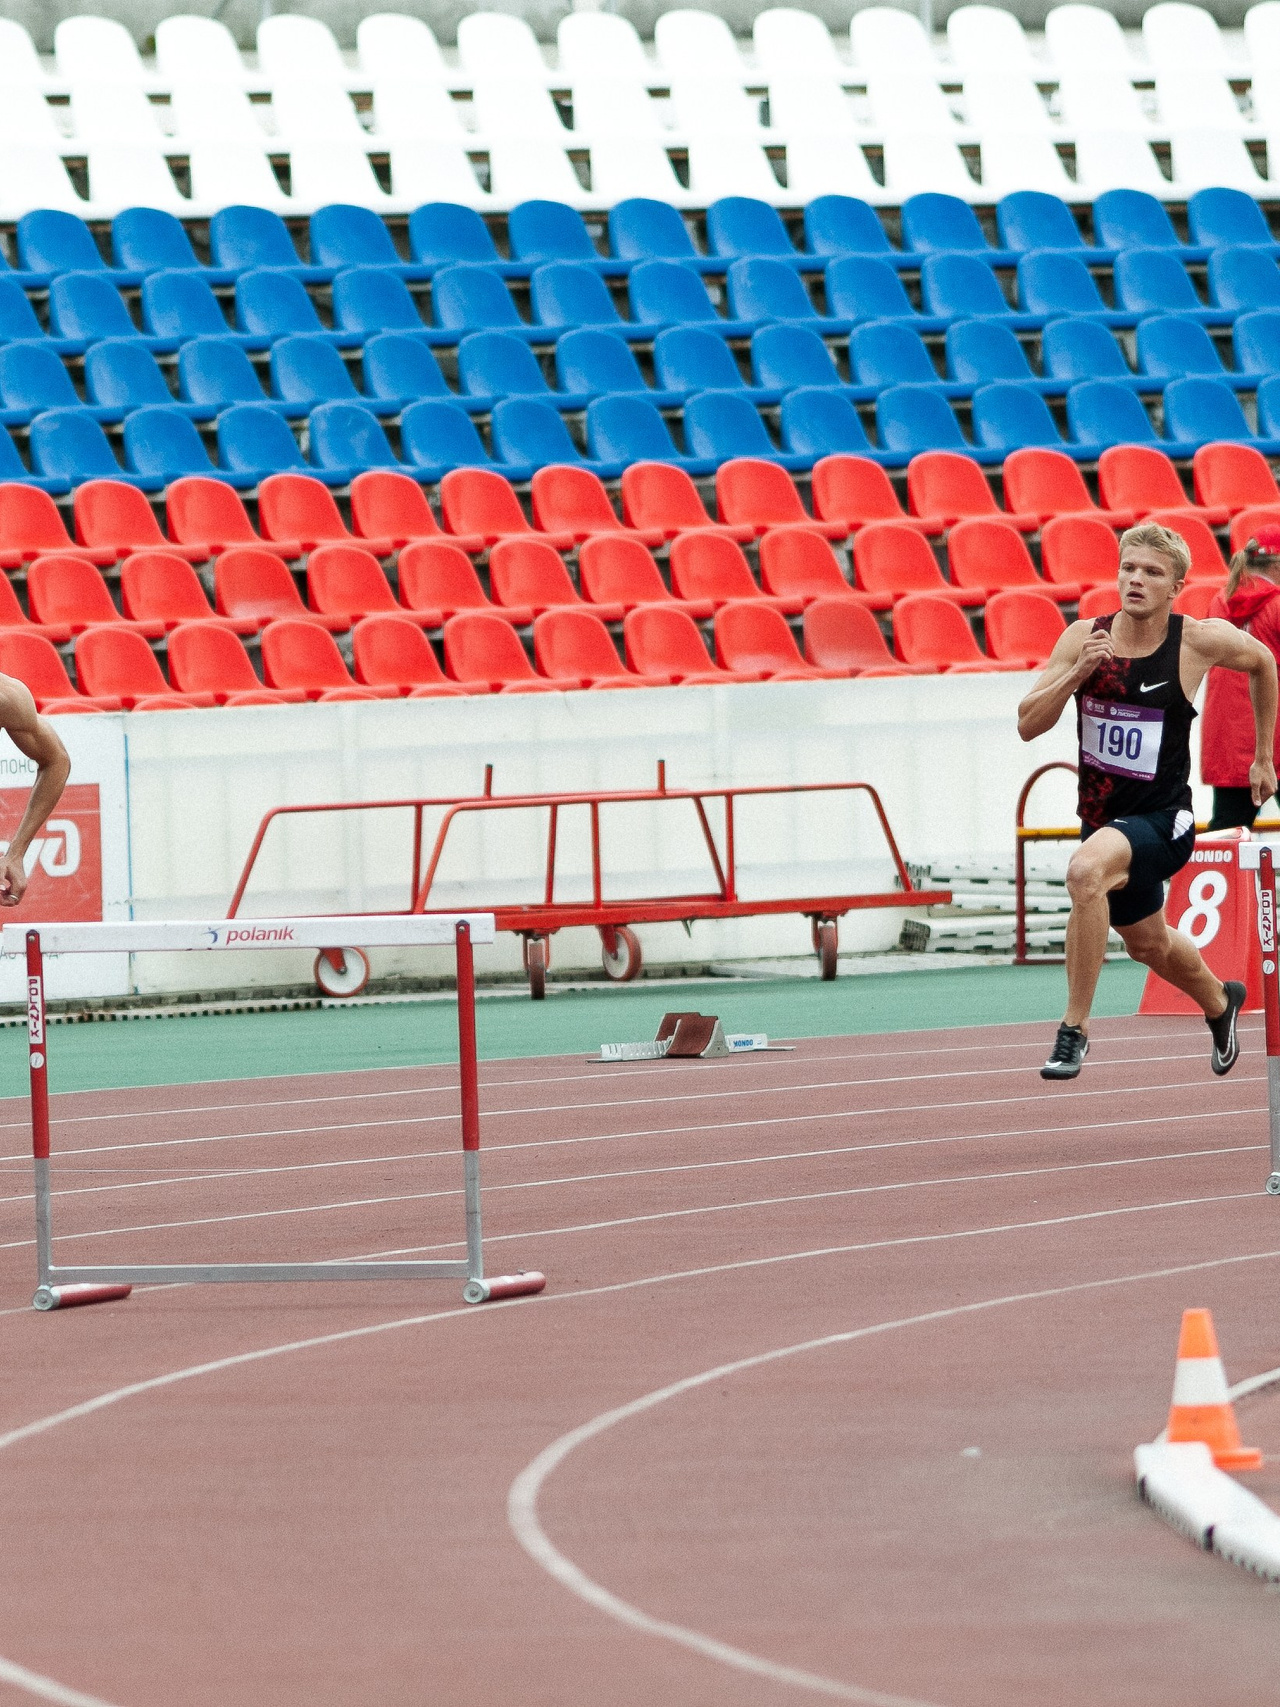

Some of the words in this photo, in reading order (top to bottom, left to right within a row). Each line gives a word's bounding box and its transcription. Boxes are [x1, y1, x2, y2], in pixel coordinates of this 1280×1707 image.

[1097, 722, 1142, 760] 190
[226, 926, 294, 946] polanik
[1177, 870, 1228, 949] 8
[1261, 891, 1272, 946] POLANIK
[29, 979, 39, 1038] POLANIK
